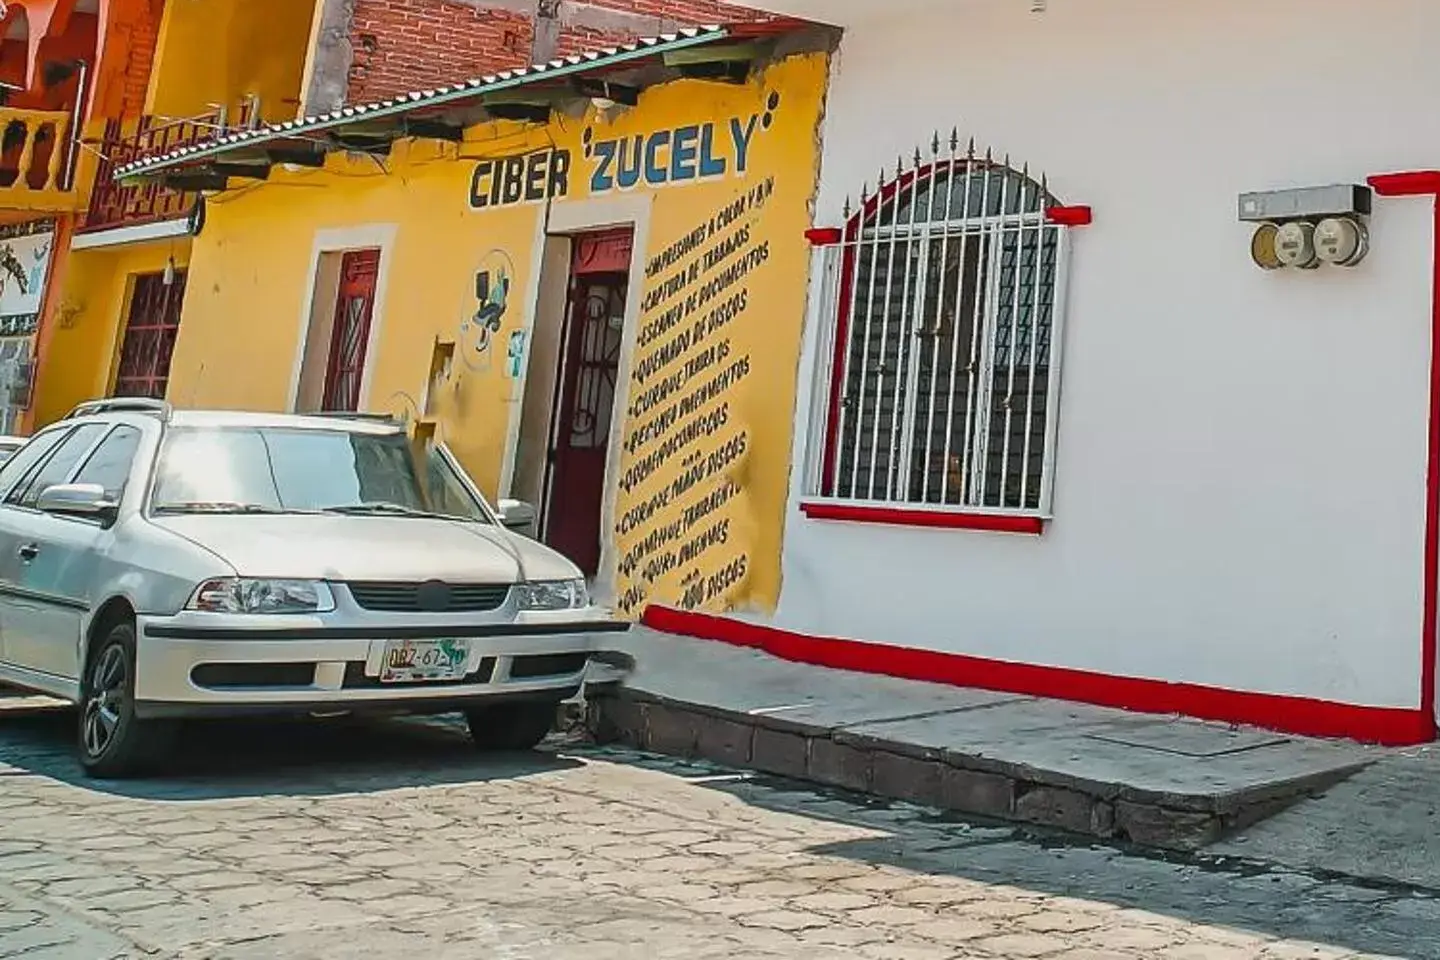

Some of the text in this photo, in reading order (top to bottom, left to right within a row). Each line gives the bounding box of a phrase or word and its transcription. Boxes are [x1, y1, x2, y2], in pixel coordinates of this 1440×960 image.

[470, 149, 572, 209] CIBER
[641, 240, 769, 348] ESCANEO DE DOCUMENTOS
[645, 267, 686, 312] CAPTURA
[688, 259, 700, 284] DE
[636, 287, 749, 385] QUEMADO DE DISCOS
